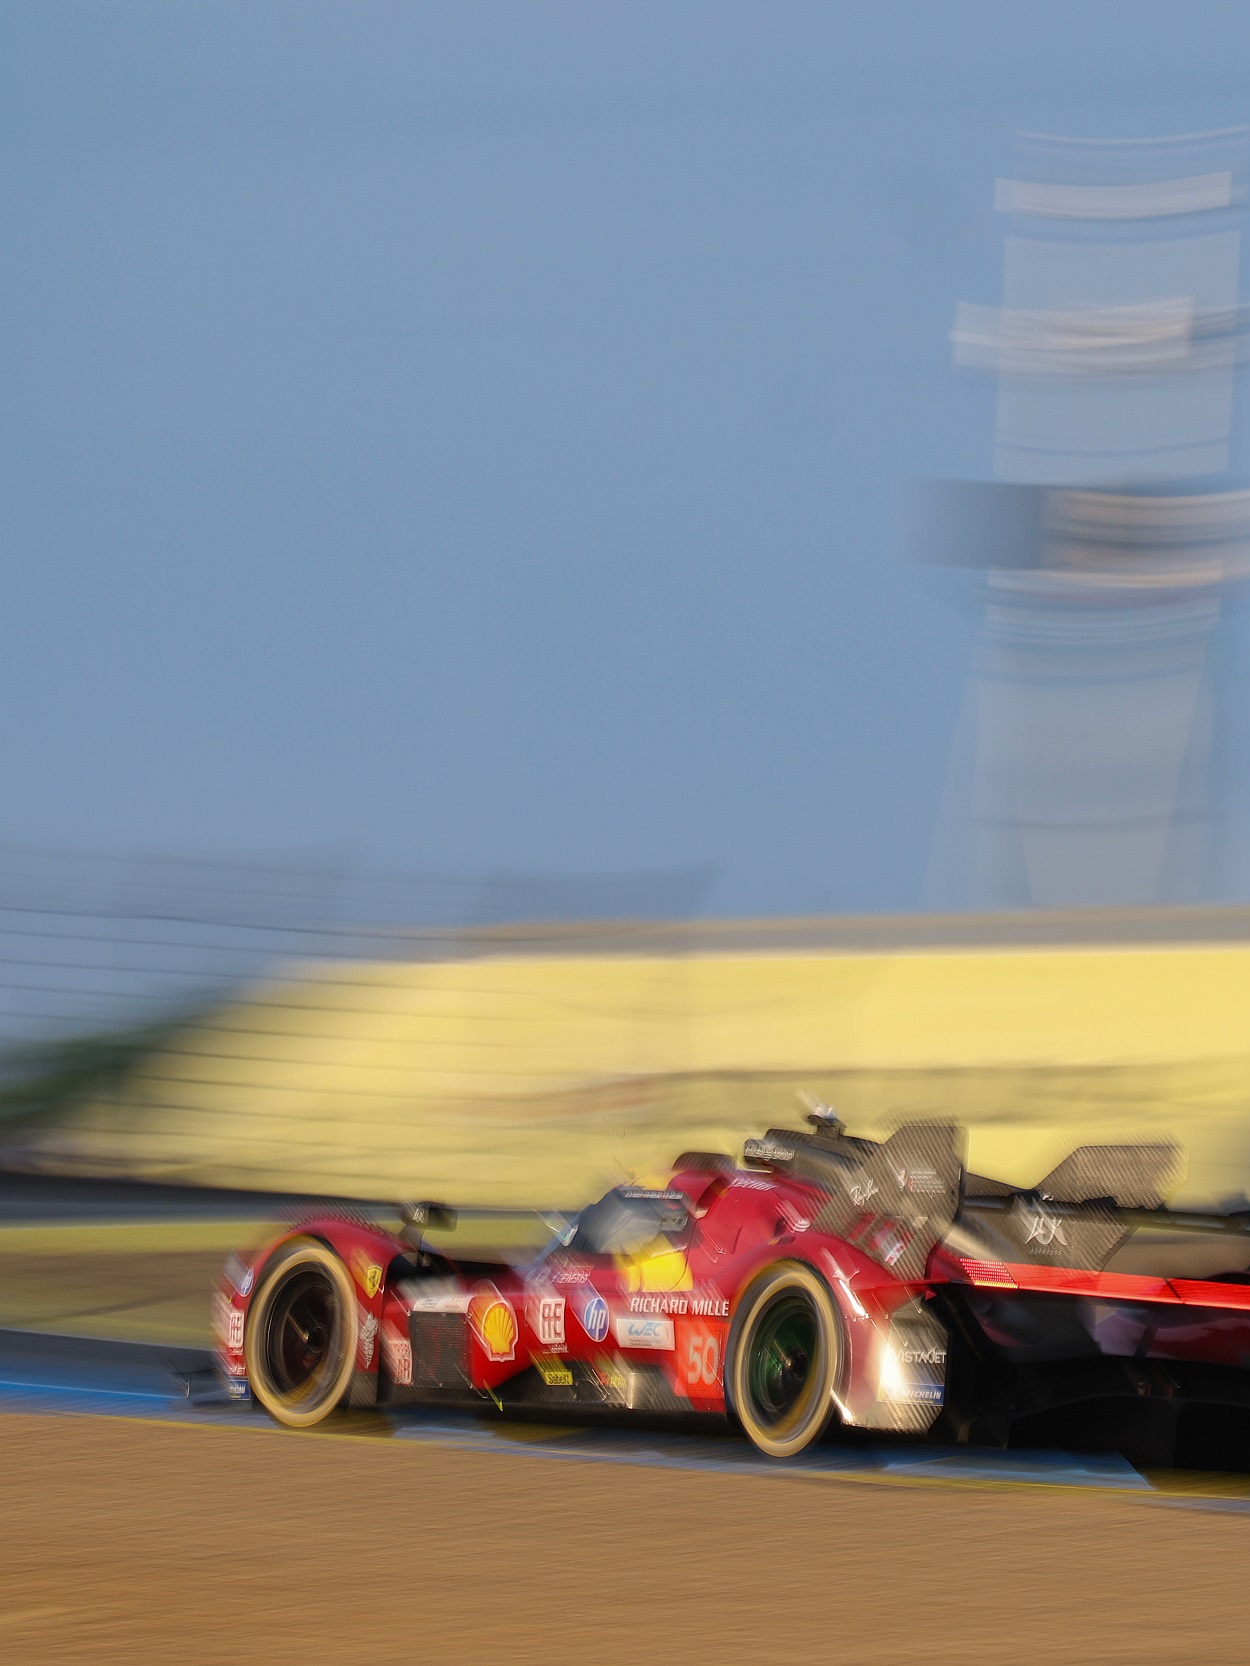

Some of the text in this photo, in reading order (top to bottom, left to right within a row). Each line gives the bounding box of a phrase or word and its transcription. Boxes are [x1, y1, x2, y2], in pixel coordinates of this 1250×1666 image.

[586, 1300, 606, 1340] hp
[630, 1297, 730, 1317] RICHARD MILLE
[688, 1336, 719, 1385] 50
[907, 1389, 942, 1400] ICHELIN
